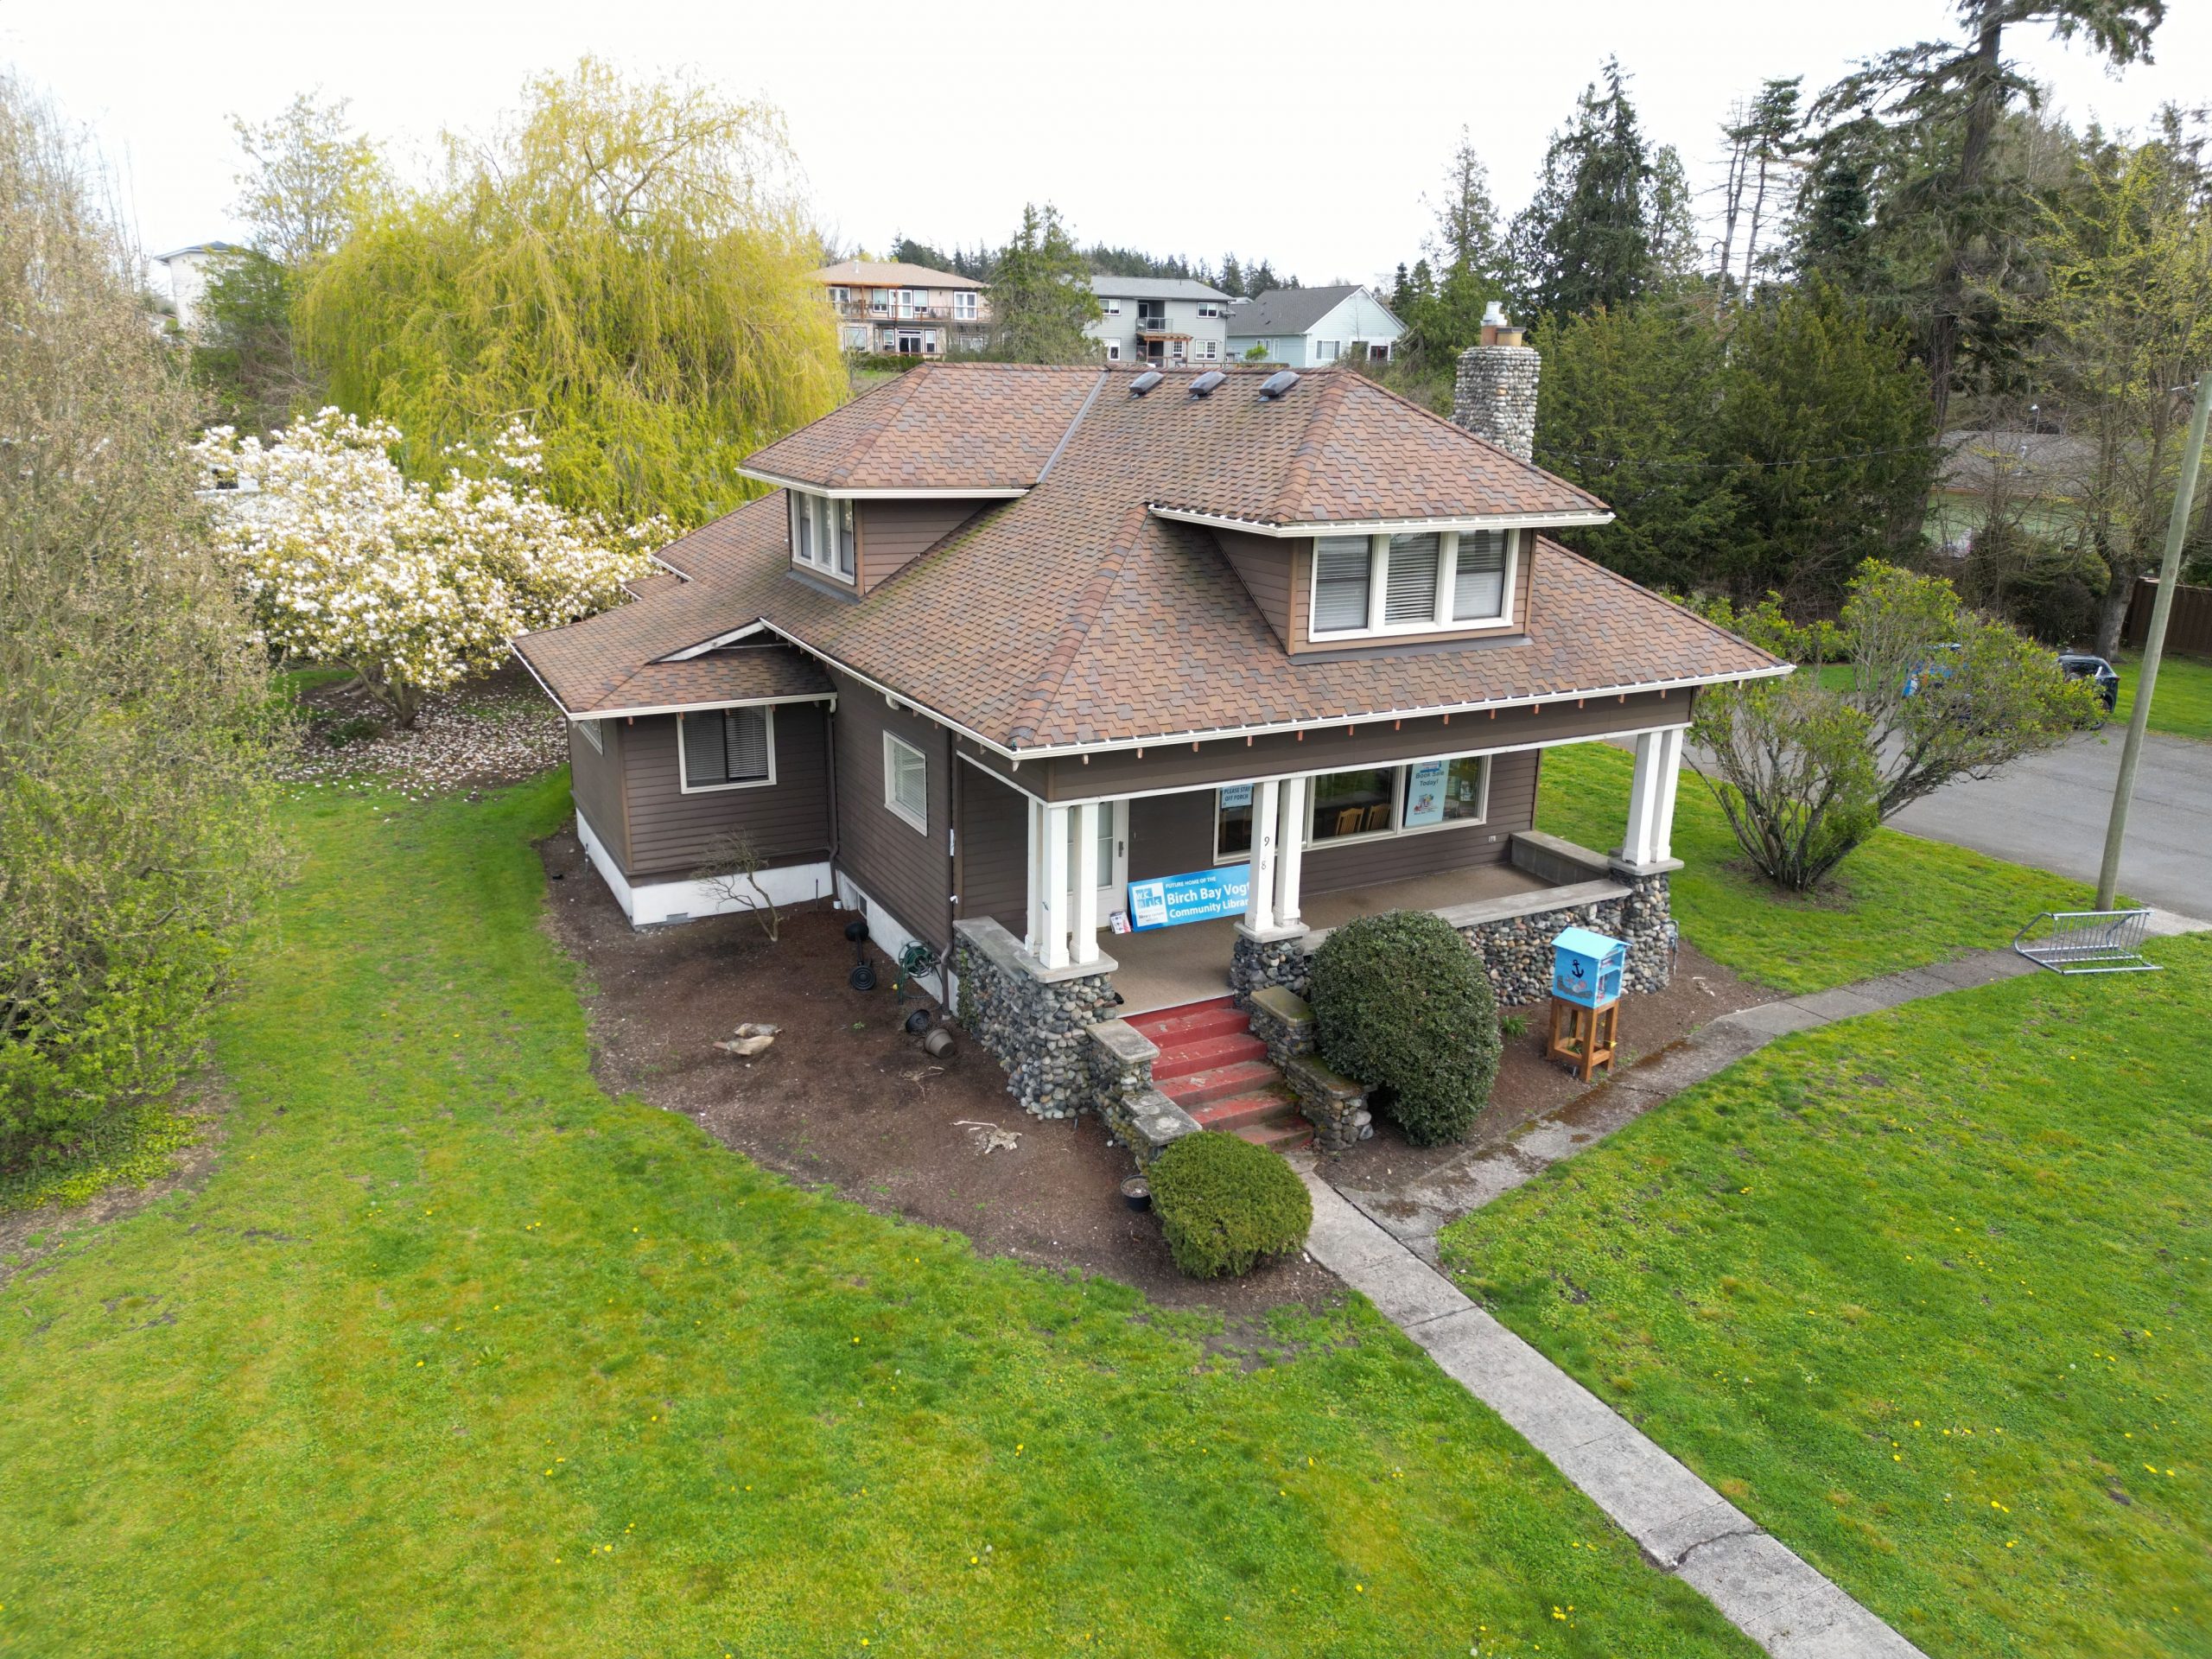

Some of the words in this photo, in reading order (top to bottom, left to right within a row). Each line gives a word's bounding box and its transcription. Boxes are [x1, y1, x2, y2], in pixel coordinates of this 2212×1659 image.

[1166, 889, 1198, 906] Birch
[1199, 887, 1222, 900] Bay
[1169, 902, 1221, 918] Community
[1223, 899, 1249, 910] Librar
